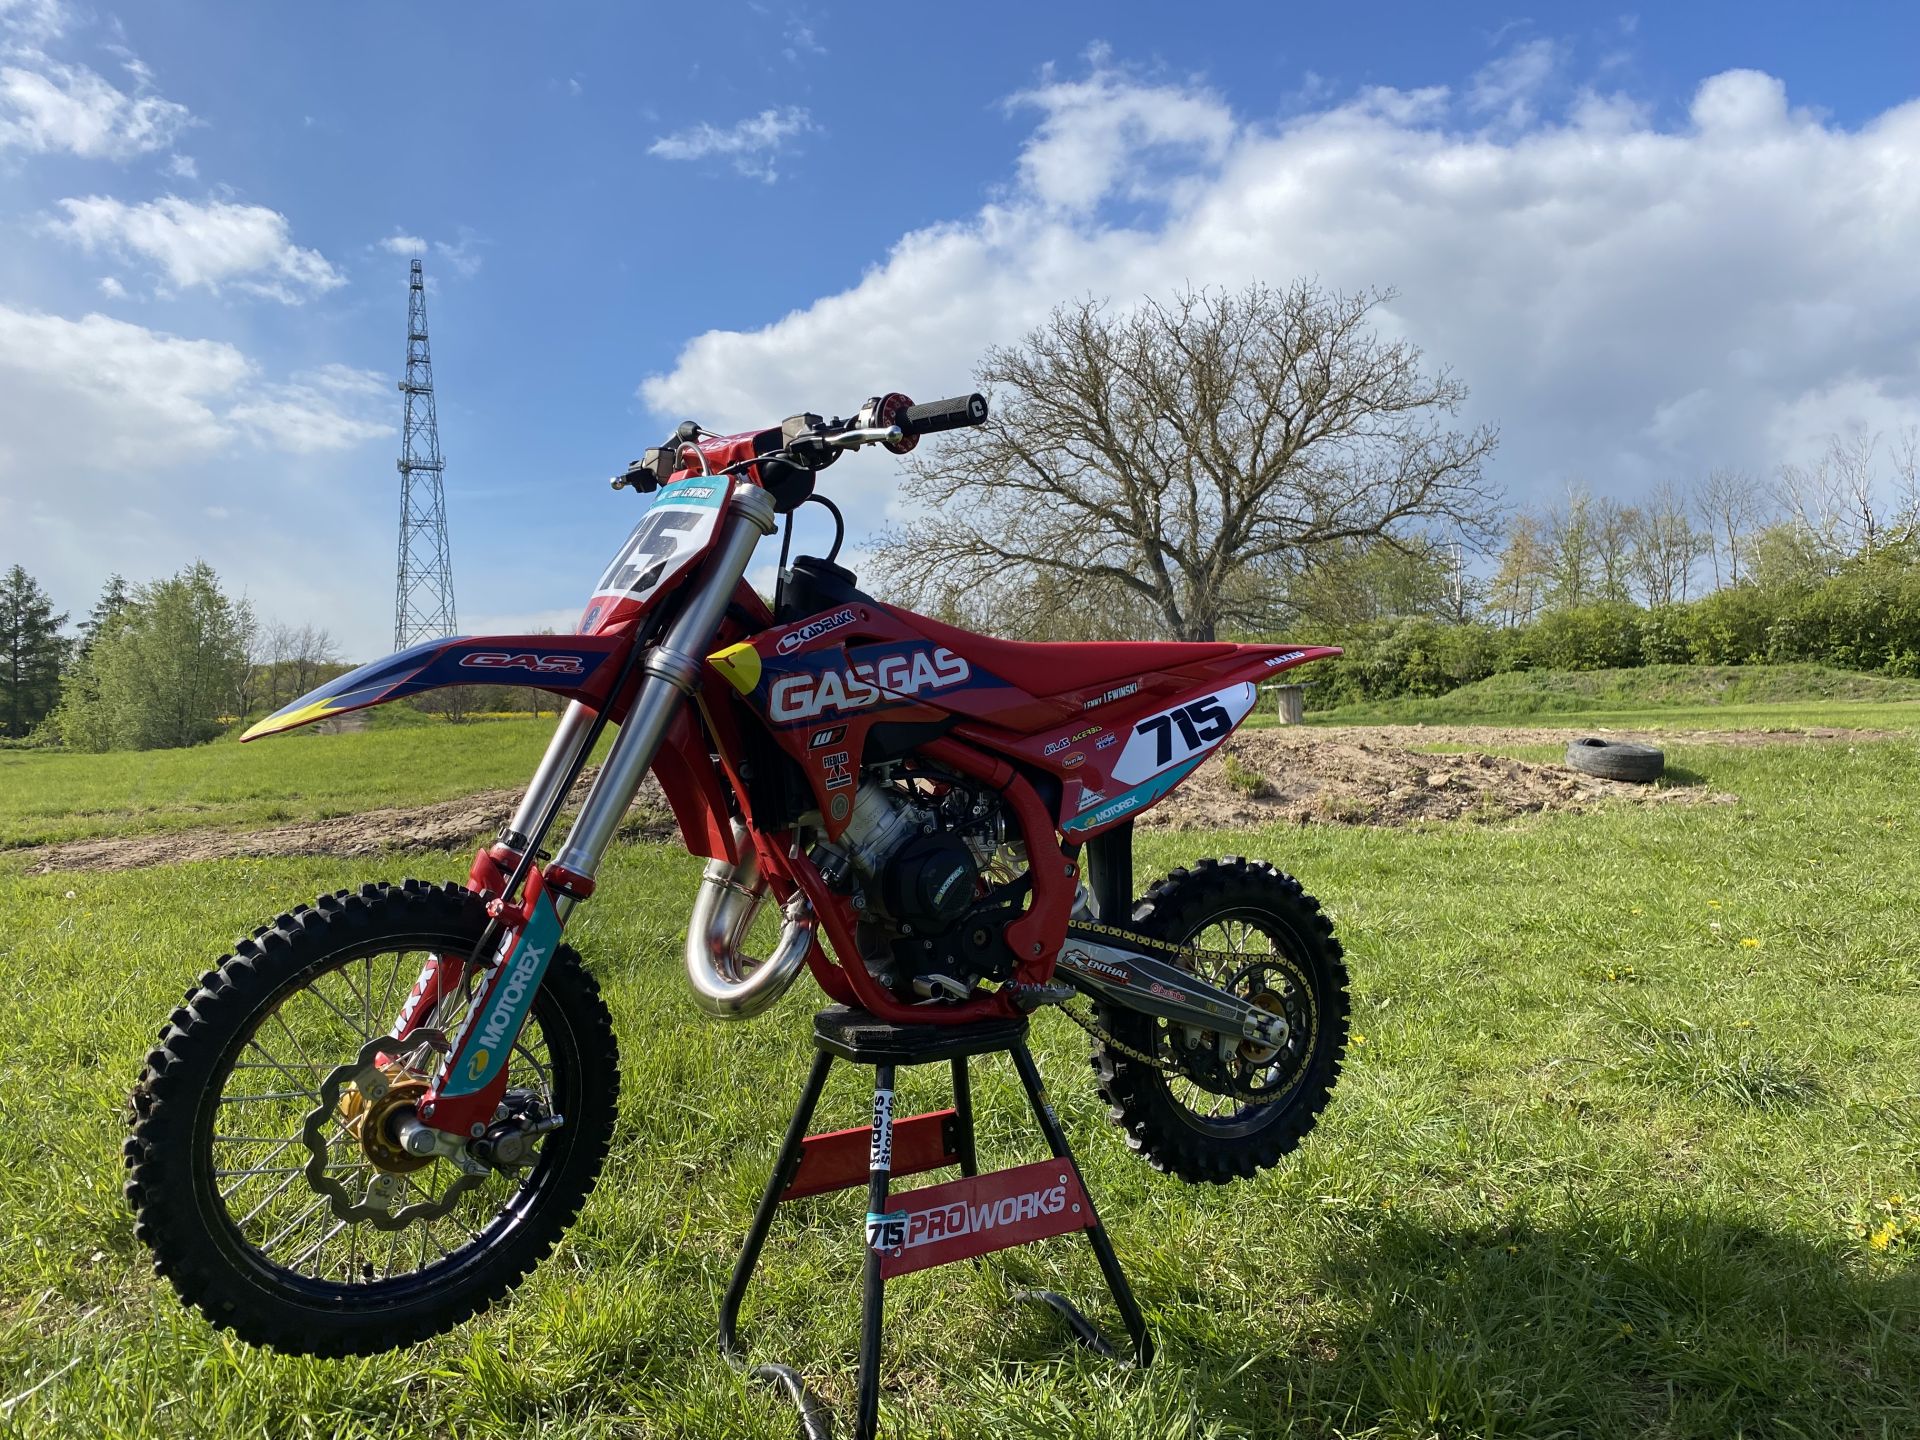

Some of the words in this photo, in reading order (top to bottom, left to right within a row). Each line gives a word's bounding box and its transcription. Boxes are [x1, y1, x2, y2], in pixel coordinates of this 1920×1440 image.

[459, 653, 583, 669] GAS
[1103, 681, 1138, 704] LEWINSKI
[1136, 695, 1233, 767] 715
[823, 752, 849, 767] FIEDLER
[1095, 795, 1140, 822] MOTOREX
[478, 940, 548, 1050] MOTOREX
[868, 1221, 906, 1246] 715
